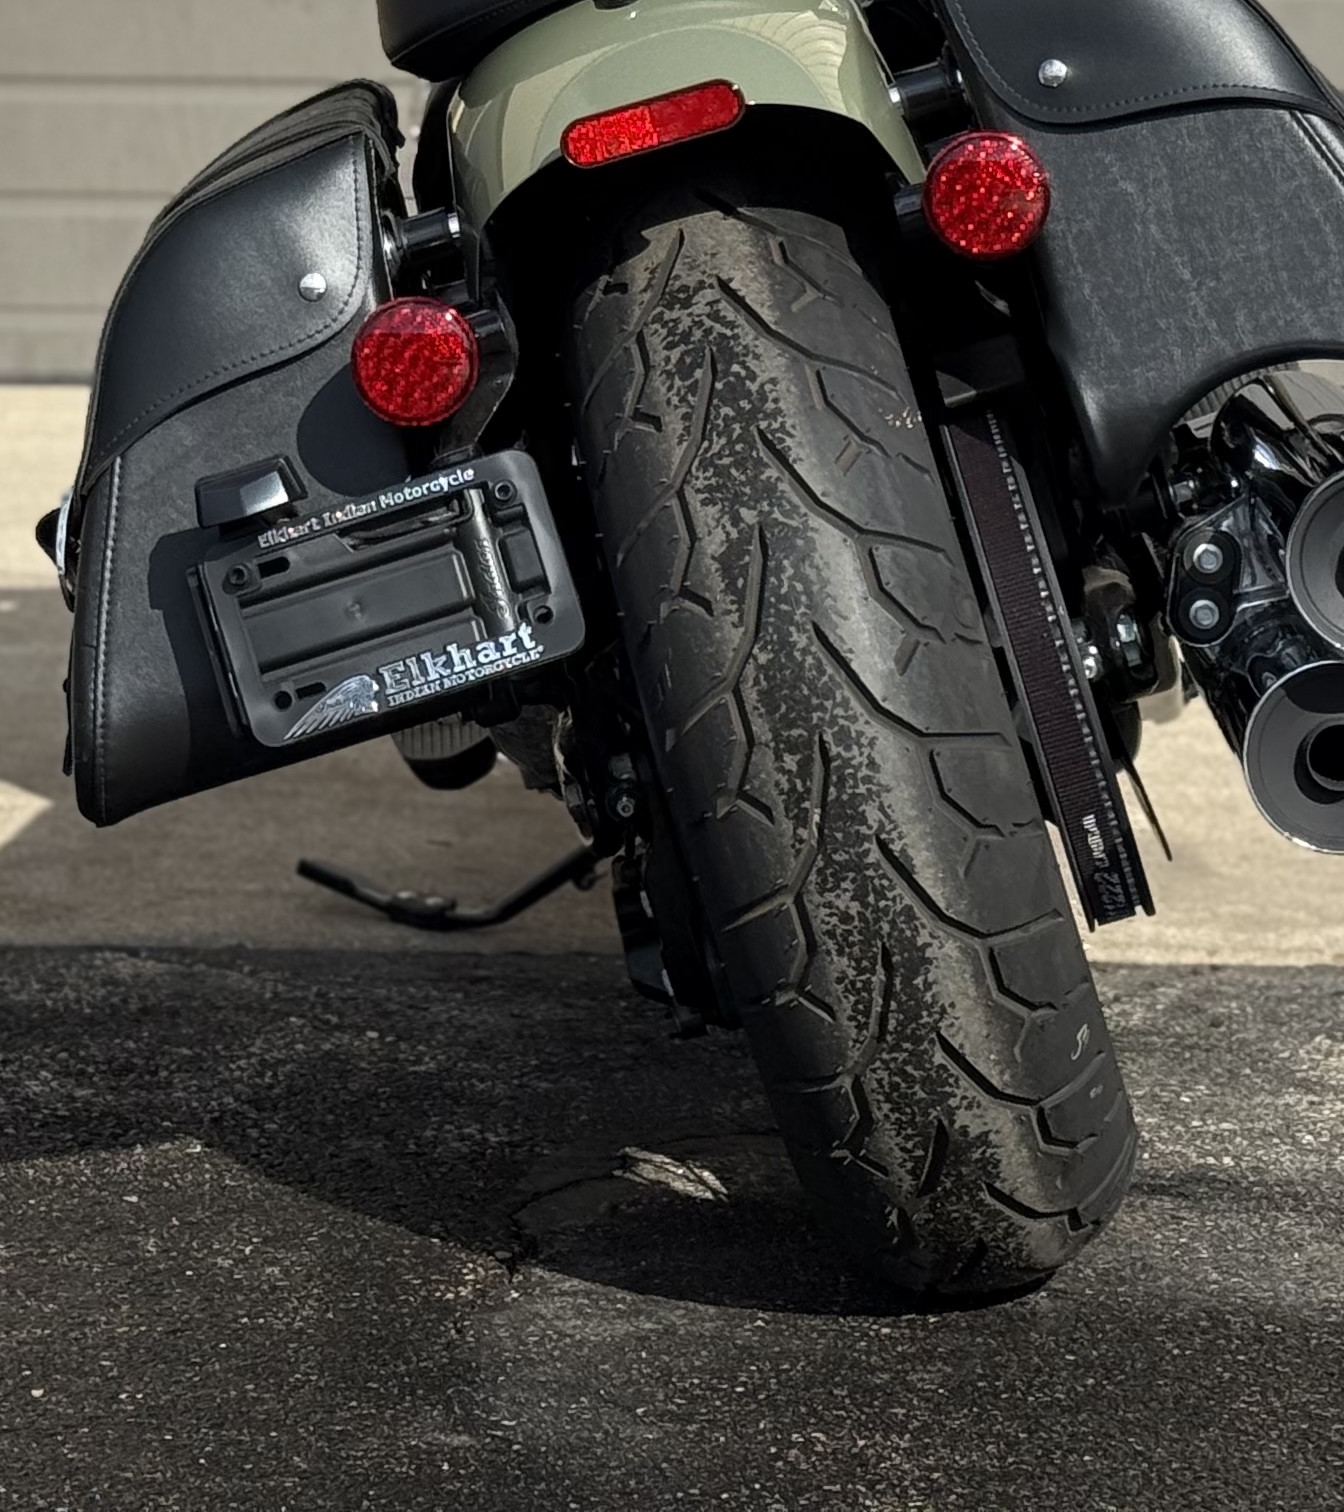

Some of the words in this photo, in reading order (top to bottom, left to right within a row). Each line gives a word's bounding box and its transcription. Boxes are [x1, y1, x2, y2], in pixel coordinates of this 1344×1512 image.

[257, 516, 322, 549] Elkhart
[322, 499, 377, 527] Indian
[379, 468, 474, 509] Motorcycle
[378, 621, 536, 694] Elkhart
[387, 680, 442, 707] INDIAN
